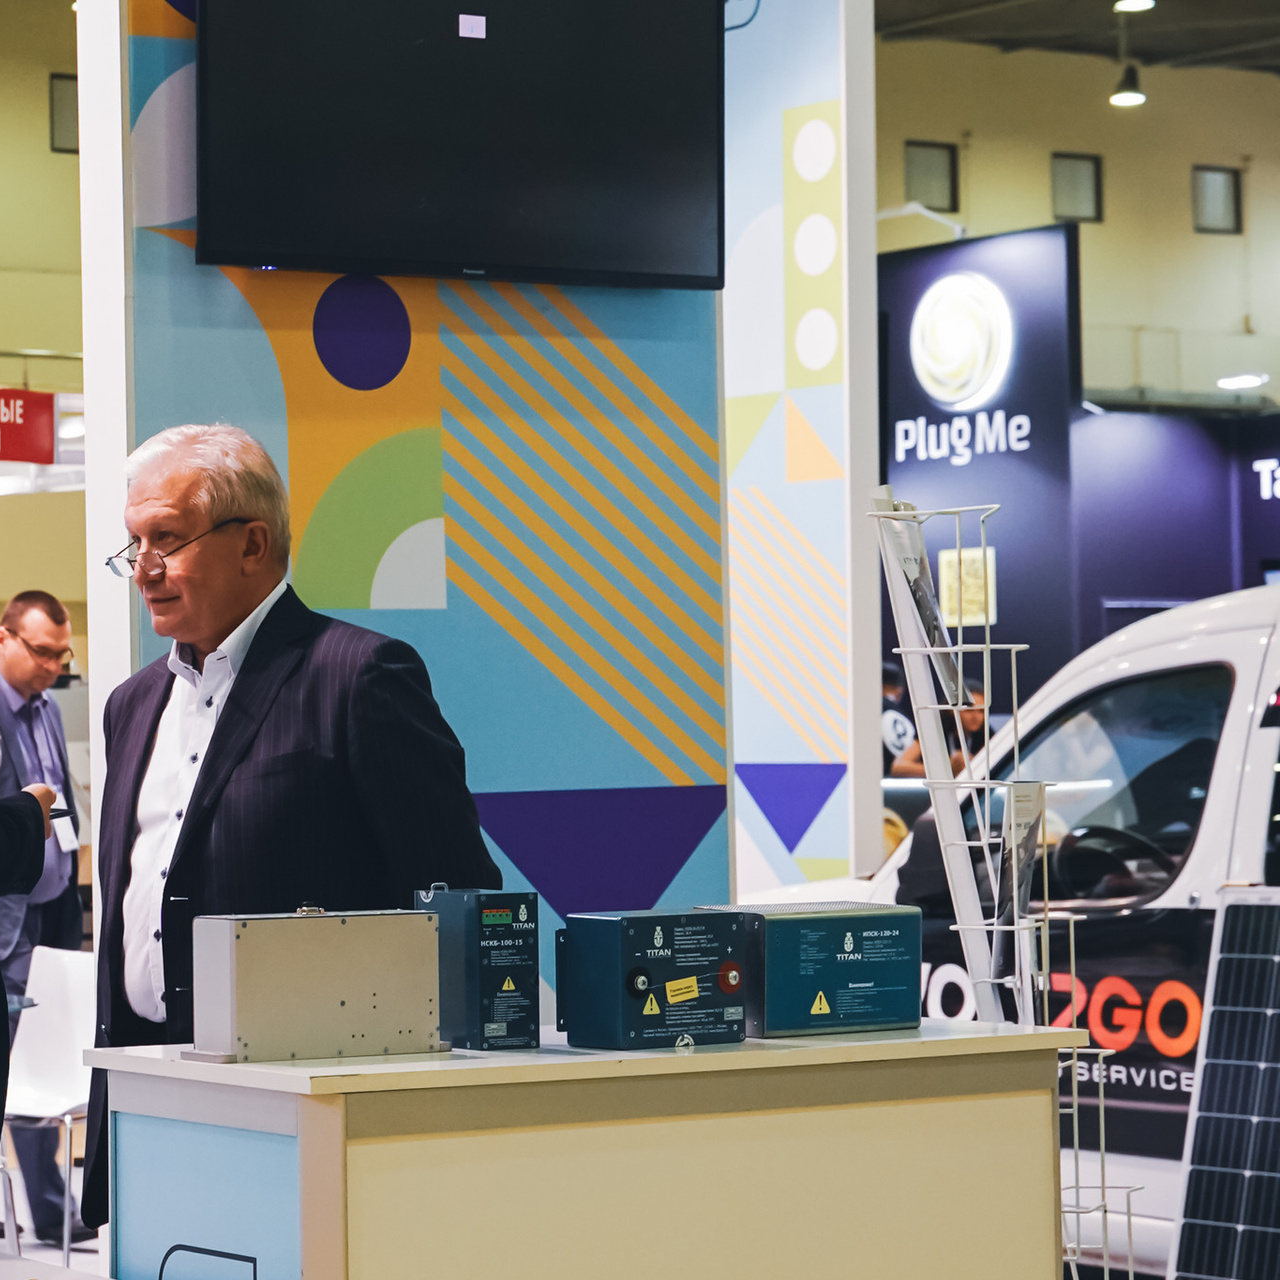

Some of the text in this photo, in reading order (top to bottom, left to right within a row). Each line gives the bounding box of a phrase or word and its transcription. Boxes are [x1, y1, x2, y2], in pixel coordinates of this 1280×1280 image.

[895, 409, 1031, 466] PlugMe
[646, 948, 671, 957] TITAN
[836, 953, 862, 961] TITAN
